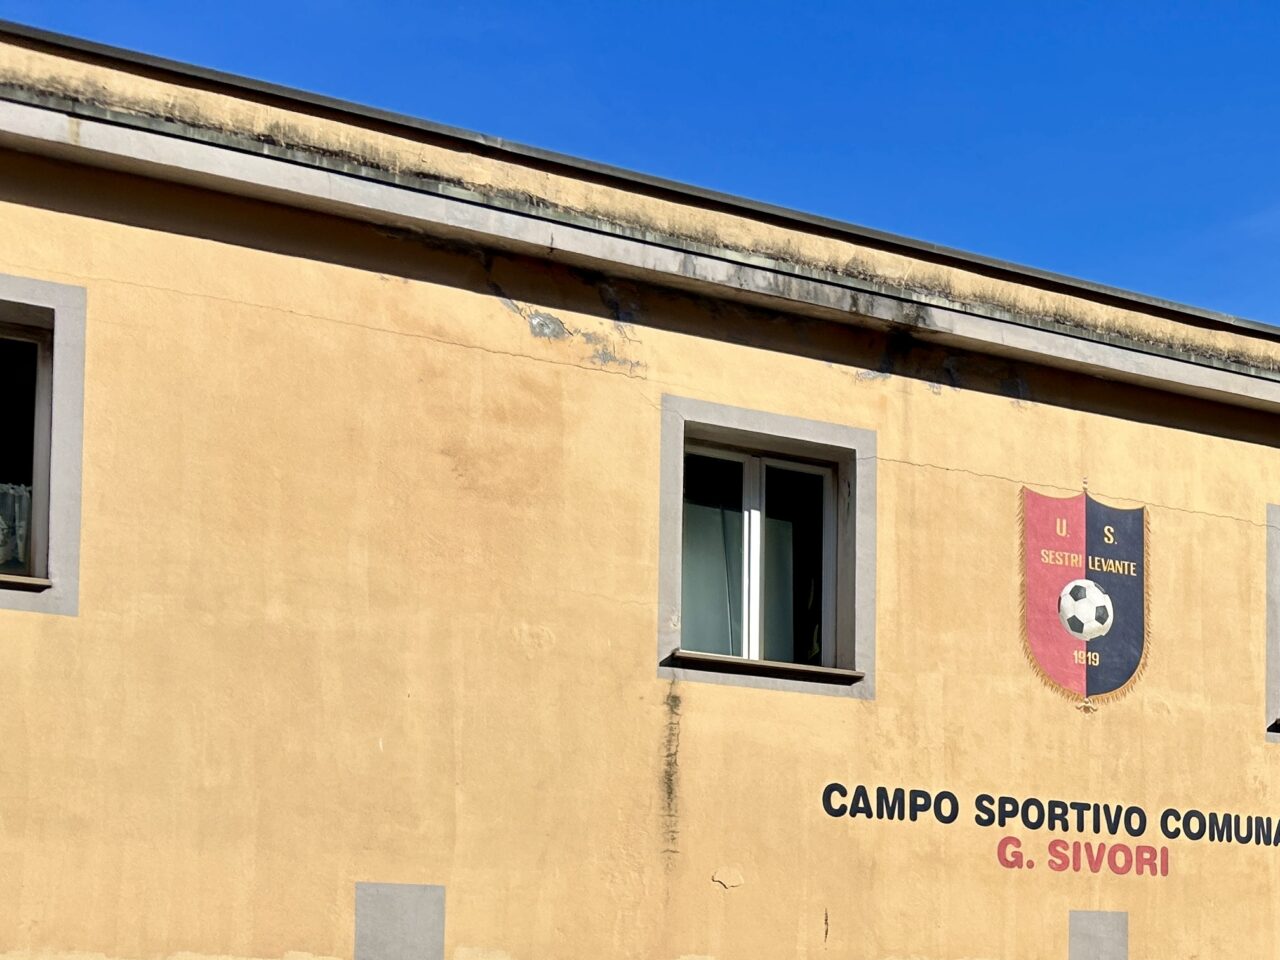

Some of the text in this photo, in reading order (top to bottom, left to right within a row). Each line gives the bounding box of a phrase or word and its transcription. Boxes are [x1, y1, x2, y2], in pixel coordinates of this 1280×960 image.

[1040, 549, 1137, 576] SESTRI LEVANTE
[1073, 650, 1100, 666] 1919
[822, 783, 959, 824] CAMPO
[975, 794, 1147, 837] SPORTIVO
[997, 836, 1169, 877] G. SIVORI
